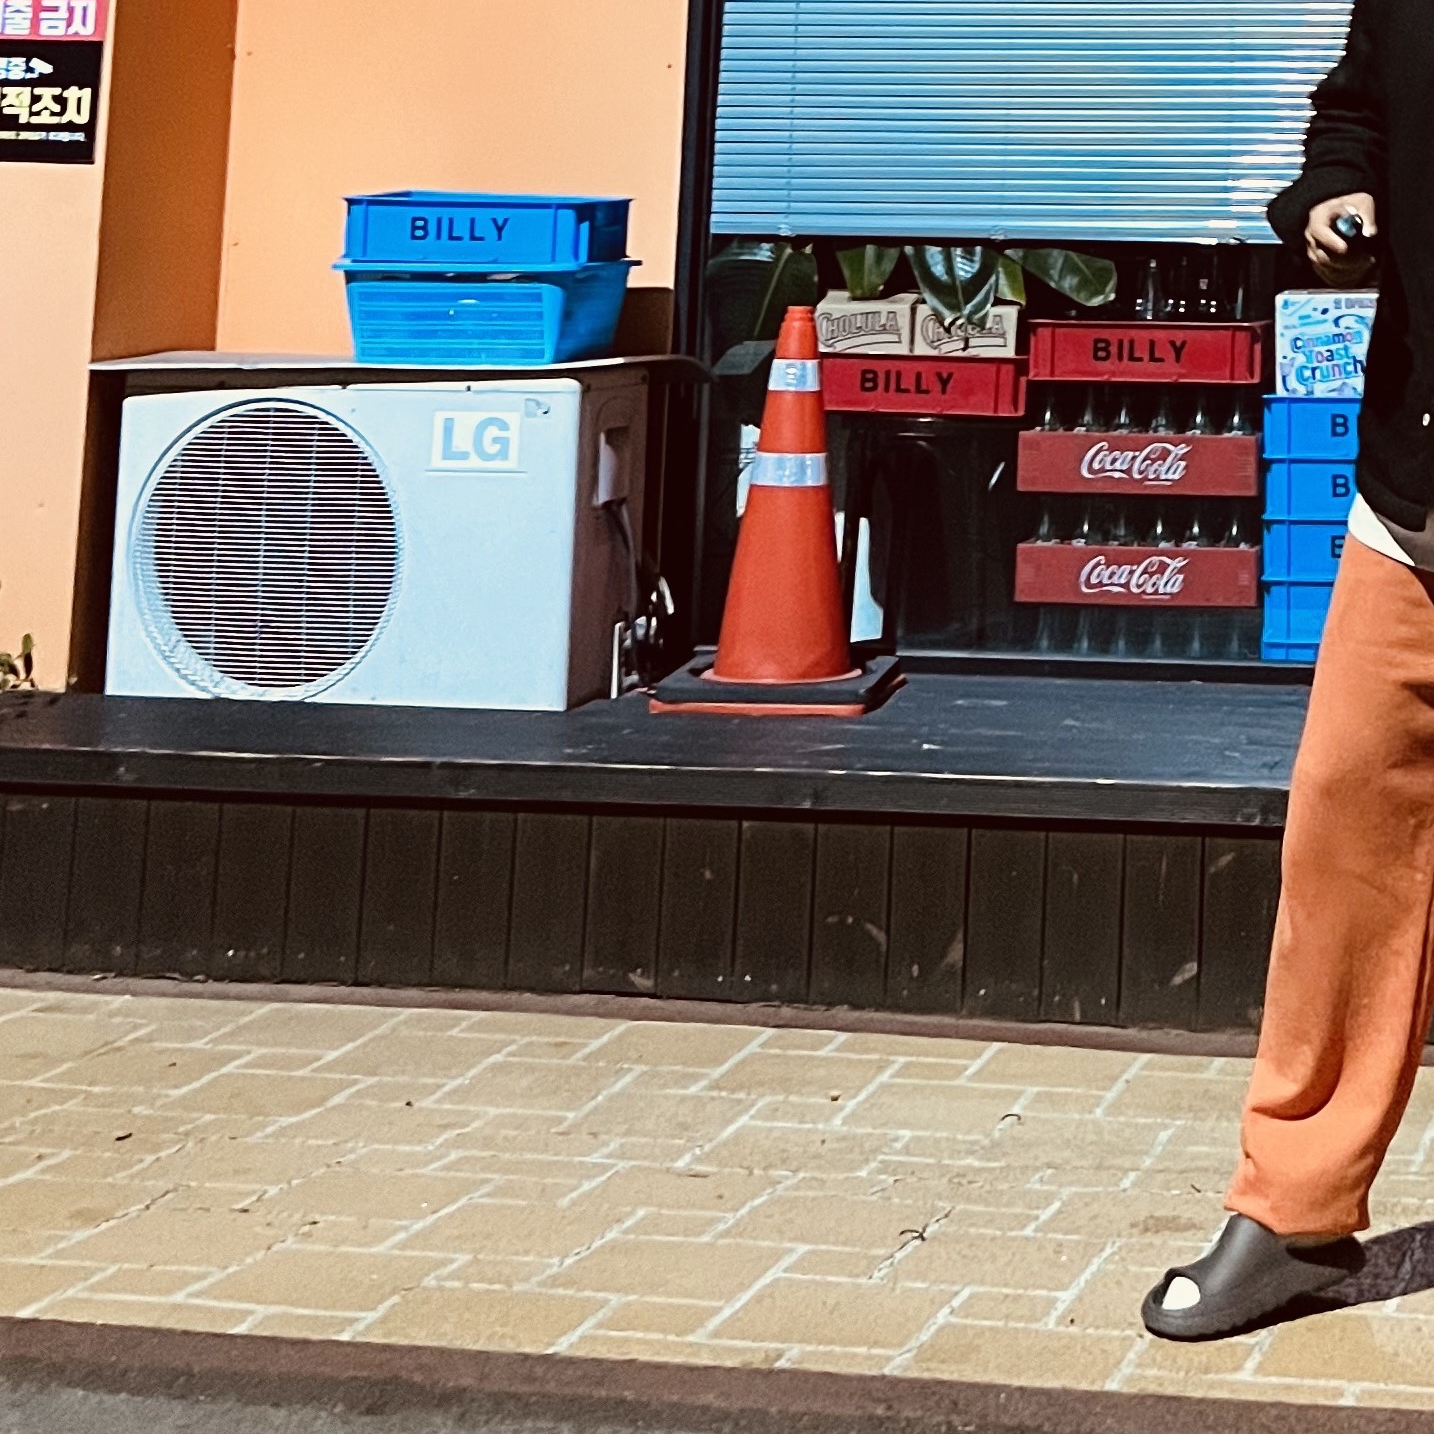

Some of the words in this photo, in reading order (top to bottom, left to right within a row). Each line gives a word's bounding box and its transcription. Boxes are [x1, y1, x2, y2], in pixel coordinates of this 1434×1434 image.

[0, 86, 92, 124] 적조치
[409, 216, 510, 243] BILLY
[1091, 337, 1188, 364] BILLY
[859, 368, 954, 395] BILLY
[440, 416, 511, 462] LG
